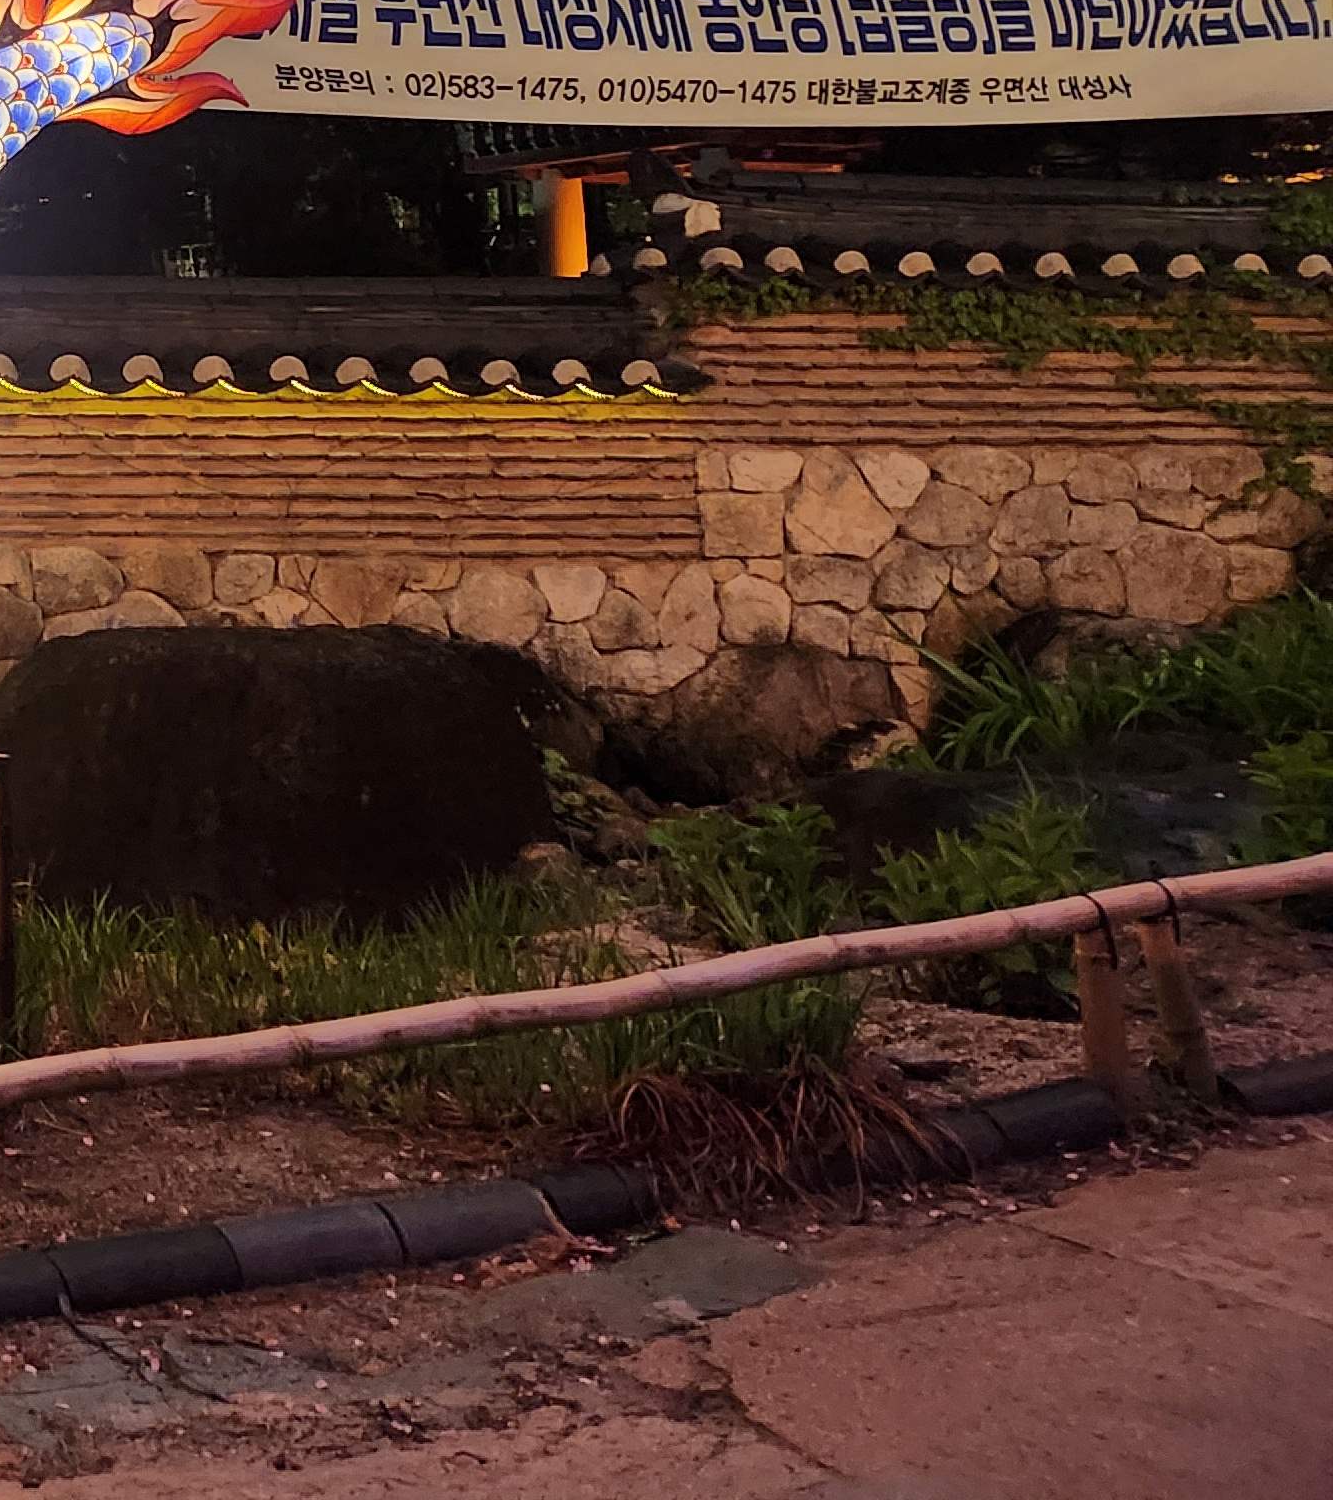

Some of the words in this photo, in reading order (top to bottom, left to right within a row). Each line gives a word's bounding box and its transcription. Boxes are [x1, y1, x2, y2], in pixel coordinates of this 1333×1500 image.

[274, 63, 375, 95] 분양문의
[385, 74, 395, 94] :
[405, 71, 587, 104] 02)583-1475,
[598, 74, 796, 106] 010)5470-1475
[808, 77, 971, 106] 대한불교조계종
[979, 76, 1050, 104] 우면산
[1058, 74, 1132, 100] 대성사
